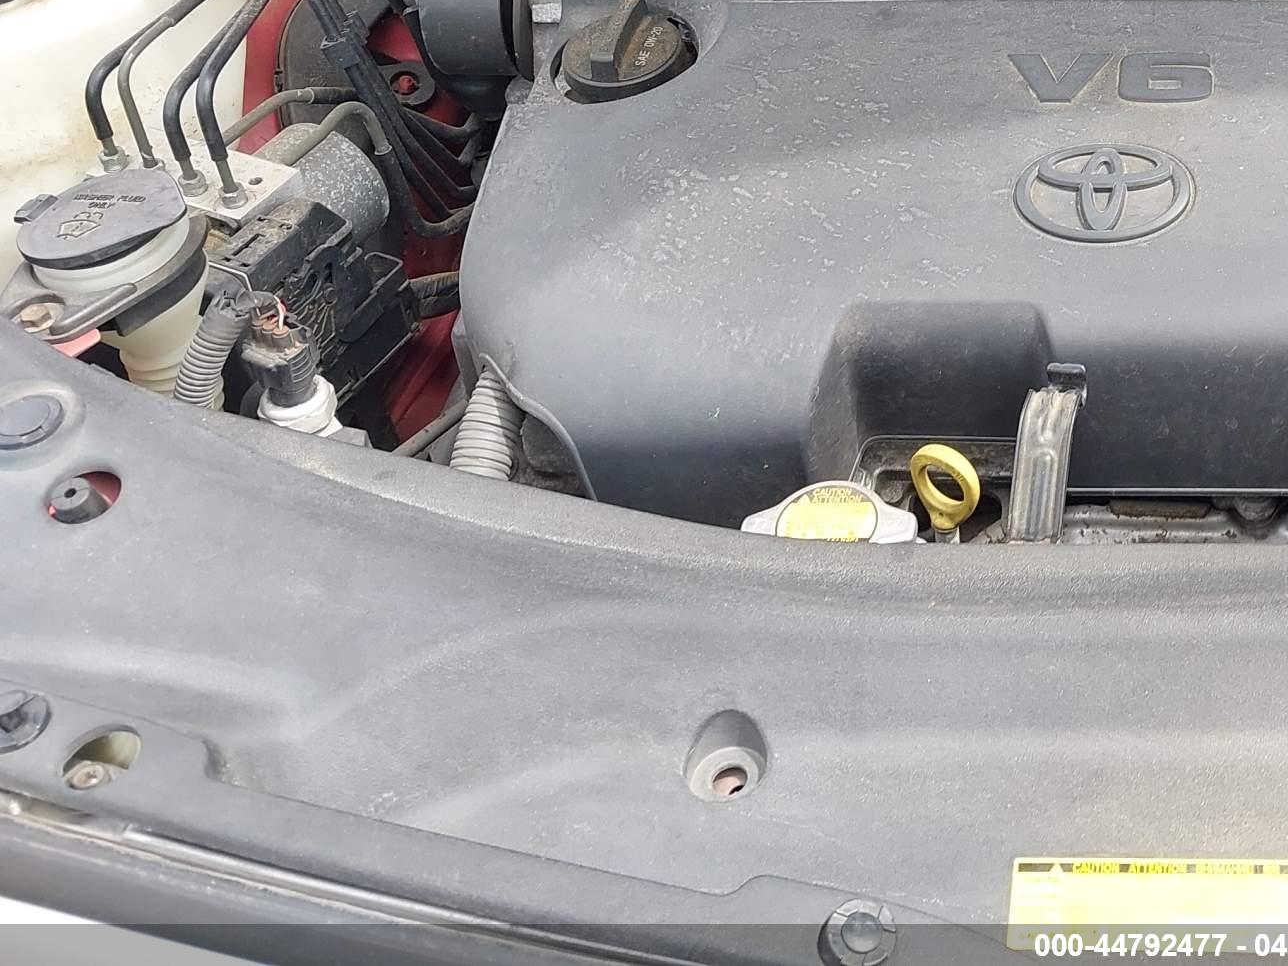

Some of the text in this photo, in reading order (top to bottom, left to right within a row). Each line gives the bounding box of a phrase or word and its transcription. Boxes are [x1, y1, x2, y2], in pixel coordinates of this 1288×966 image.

[635, 50, 650, 67] SAE
[1007, 52, 1215, 103] V6
[813, 488, 852, 497] CAUTION
[811, 495, 862, 504] ATTENTION
[1072, 863, 1187, 874] CAUTION ATTENTION
